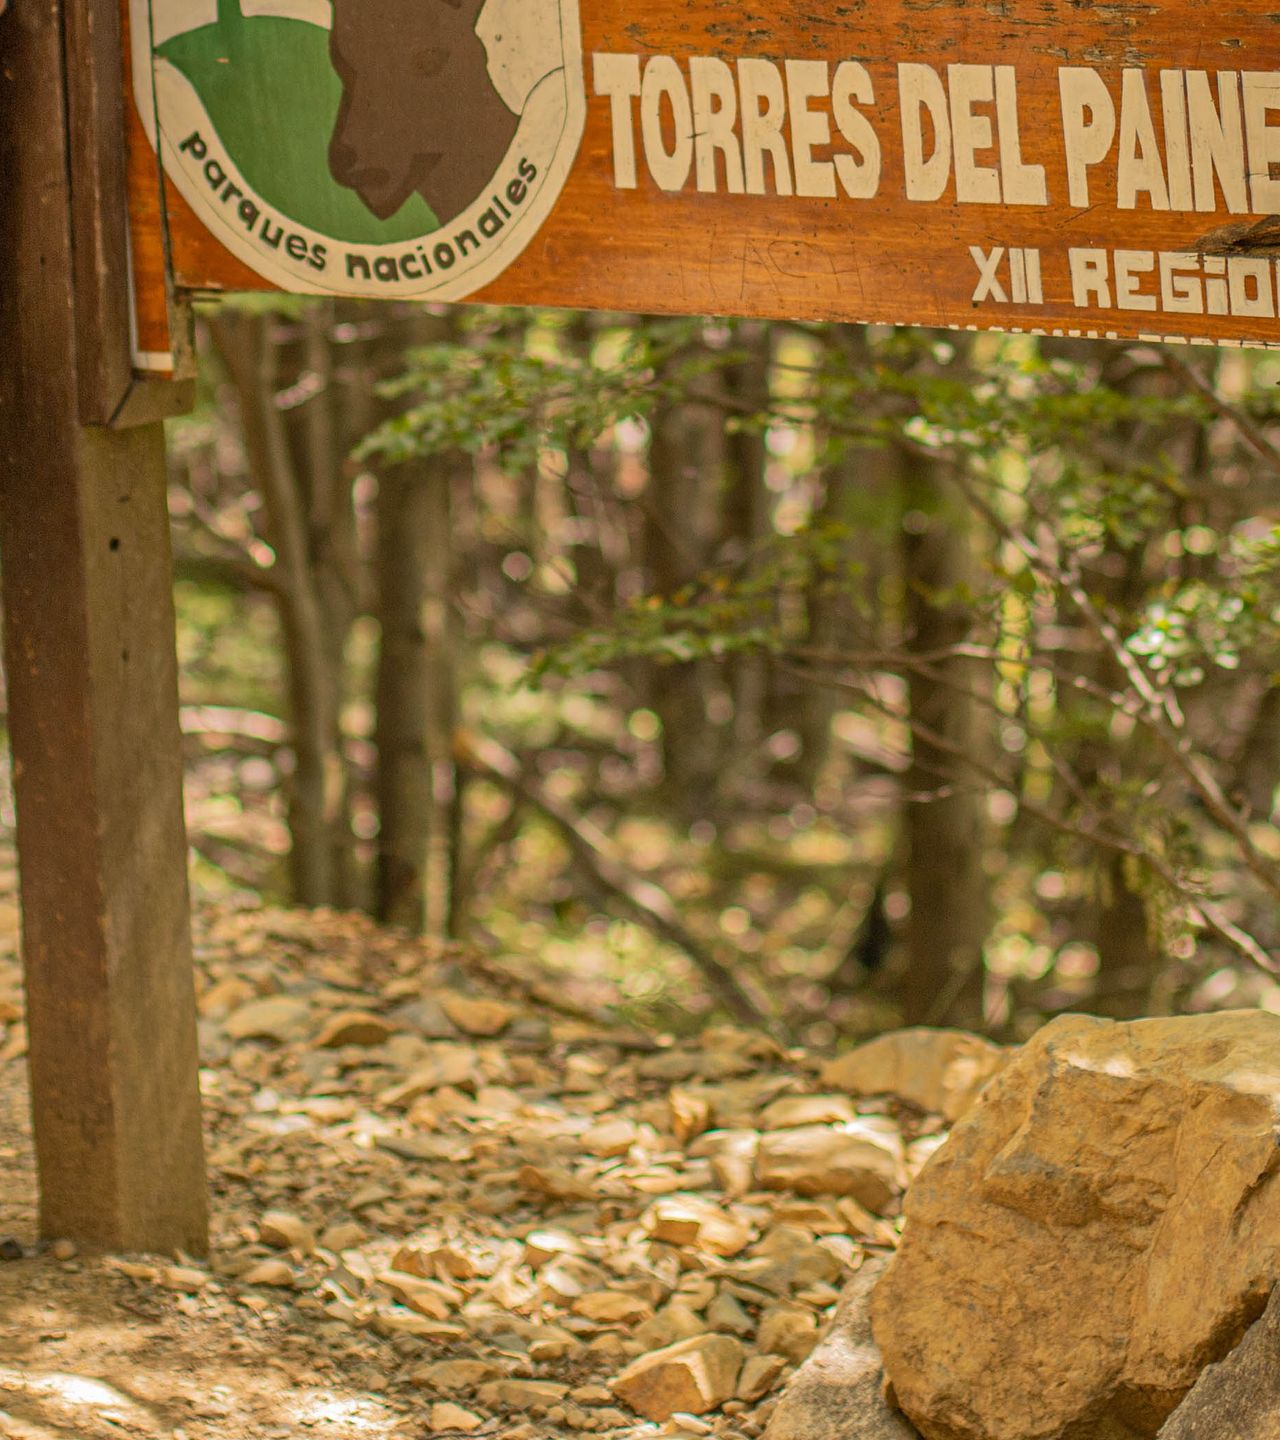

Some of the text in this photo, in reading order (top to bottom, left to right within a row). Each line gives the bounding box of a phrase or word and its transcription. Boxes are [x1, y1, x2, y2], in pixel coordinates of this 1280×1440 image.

[593, 53, 881, 199] TORRES
[898, 63, 1048, 206] DEL
[179, 130, 327, 271] parques
[345, 156, 538, 282] nacionales
[969, 245, 1044, 304] XII
